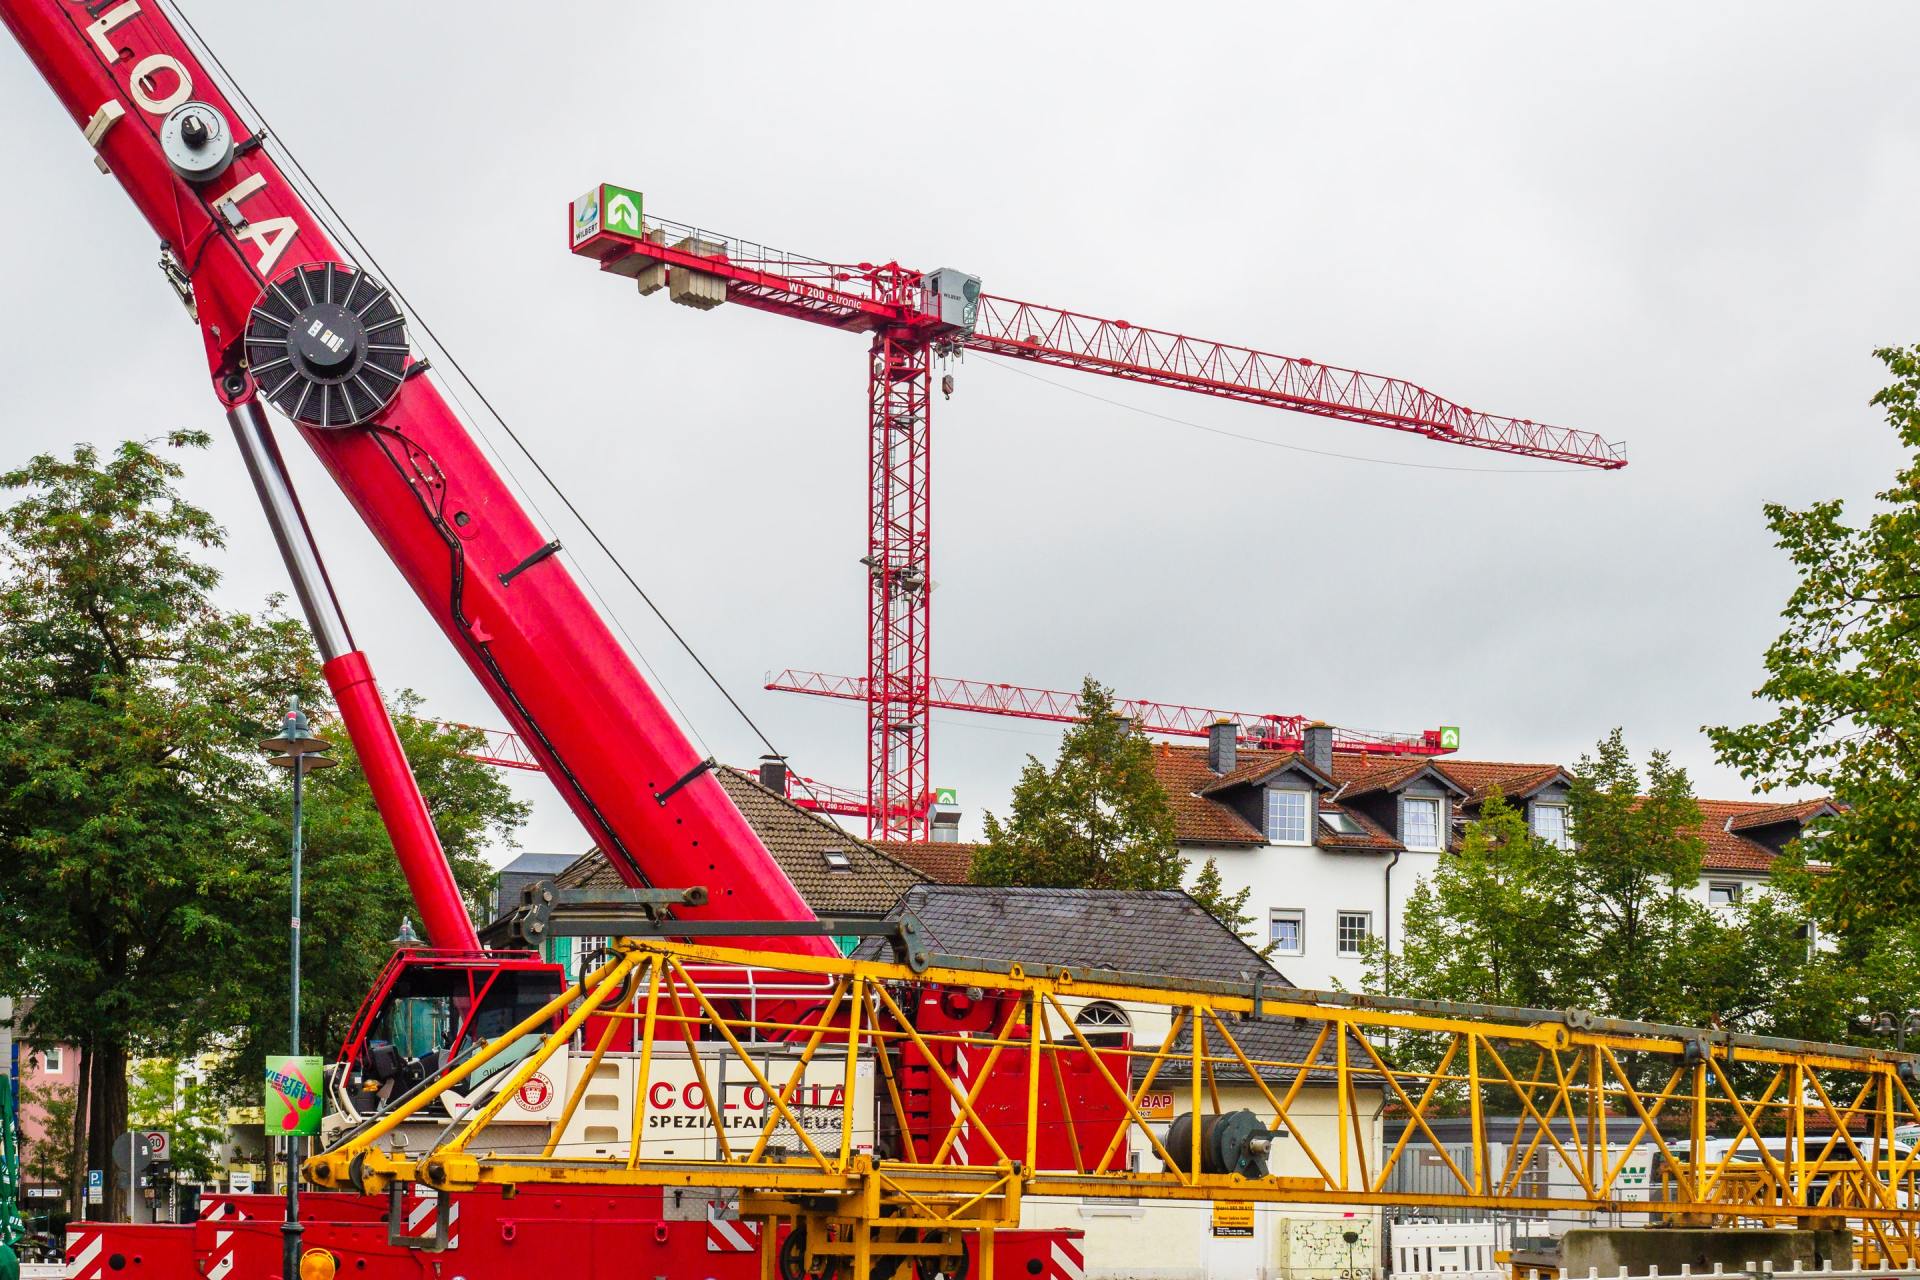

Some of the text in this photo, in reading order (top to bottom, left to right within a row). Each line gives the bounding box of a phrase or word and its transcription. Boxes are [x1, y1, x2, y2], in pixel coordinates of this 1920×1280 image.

[68, 0, 299, 277] LOIA
[576, 223, 598, 240] WILBERT
[789, 282, 862, 309] WT 200 e.tronic
[649, 1116, 854, 1129] SPEZIALFAREUG
[150, 1138, 160, 1147] 30
